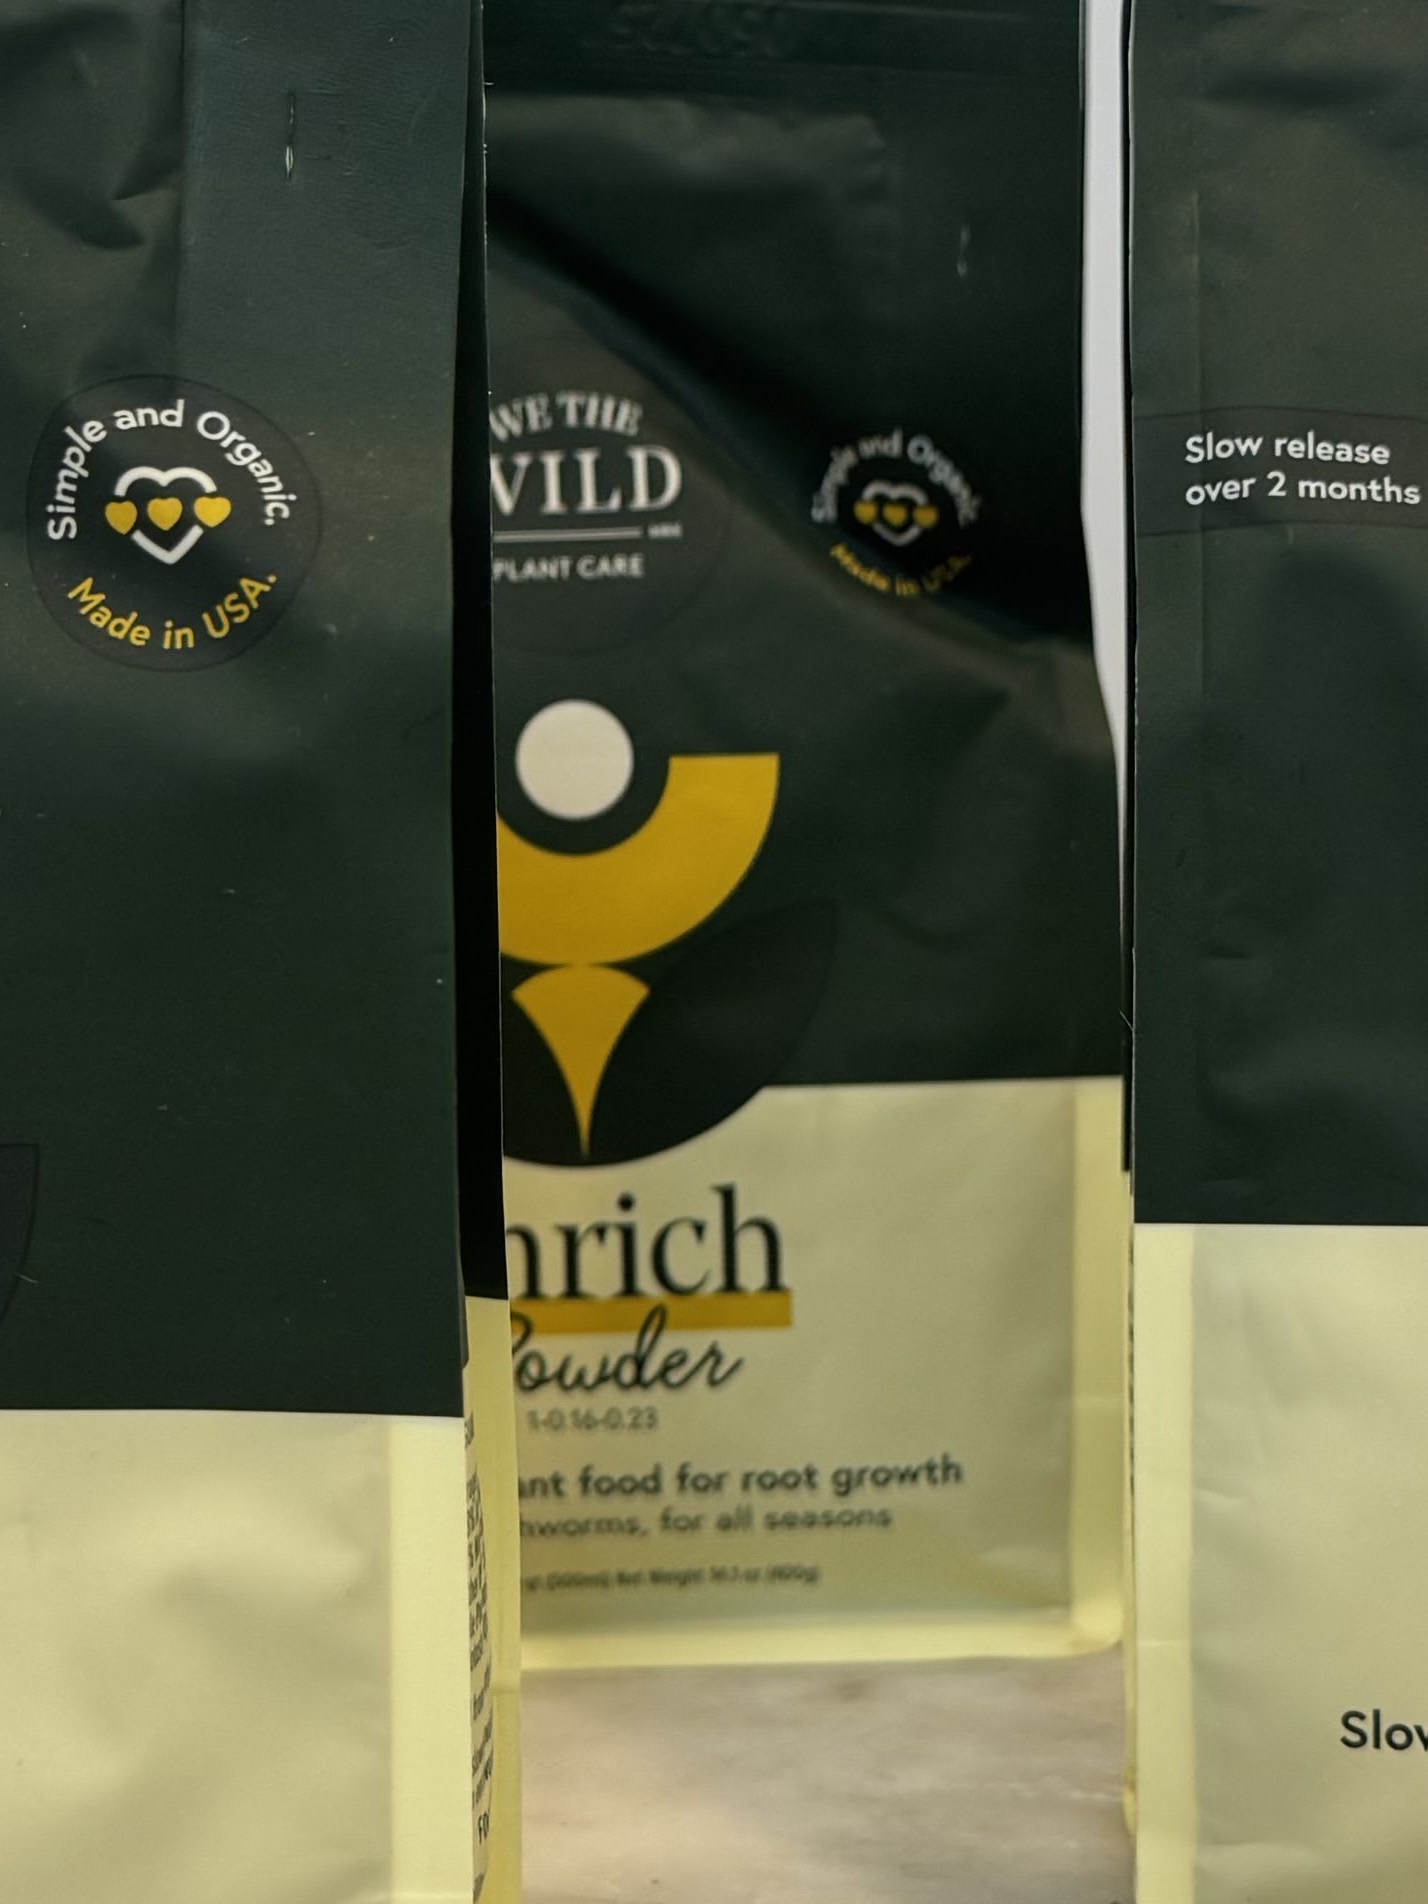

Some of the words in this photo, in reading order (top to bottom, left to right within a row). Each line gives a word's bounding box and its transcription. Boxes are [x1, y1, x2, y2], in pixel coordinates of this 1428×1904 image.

[556, 391, 643, 437] THE
[1185, 431, 1263, 464] Slow
[1274, 429, 1390, 464] release
[47, 420, 107, 540] Simple
[113, 399, 185, 429] and
[196, 411, 297, 526] Organic.
[1185, 477, 1256, 505] over
[1266, 470, 1286, 496] 2
[1298, 475, 1420, 504] months
[576, 553, 645, 579] CARE
[68, 577, 151, 645] Made
[163, 620, 194, 649] in
[202, 574, 276, 638] USA.
[579, 1463, 662, 1496] food
[676, 1462, 729, 1494] for
[741, 1463, 818, 1493] root
[832, 1453, 964, 1496] growth
[660, 1507, 705, 1533] for
[715, 1505, 753, 1532] all
[763, 1506, 893, 1531] seasons
